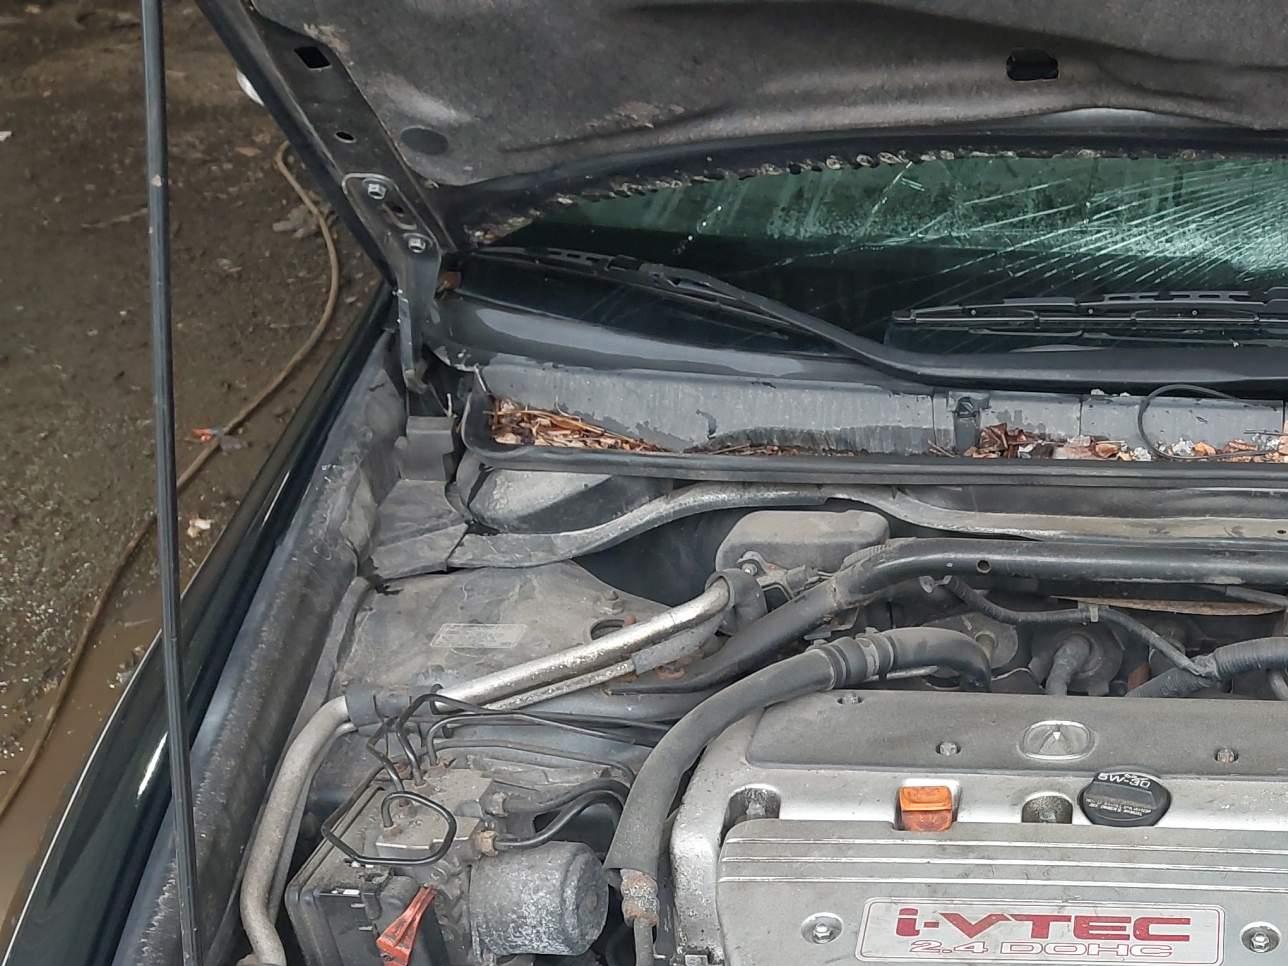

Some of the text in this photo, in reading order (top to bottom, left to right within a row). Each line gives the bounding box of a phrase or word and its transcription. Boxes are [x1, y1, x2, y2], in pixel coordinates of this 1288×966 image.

[1097, 772, 1152, 789] 5W-30
[895, 907, 1191, 942] i-VTEC
[908, 939, 1174, 958] 2.4 DOHC
